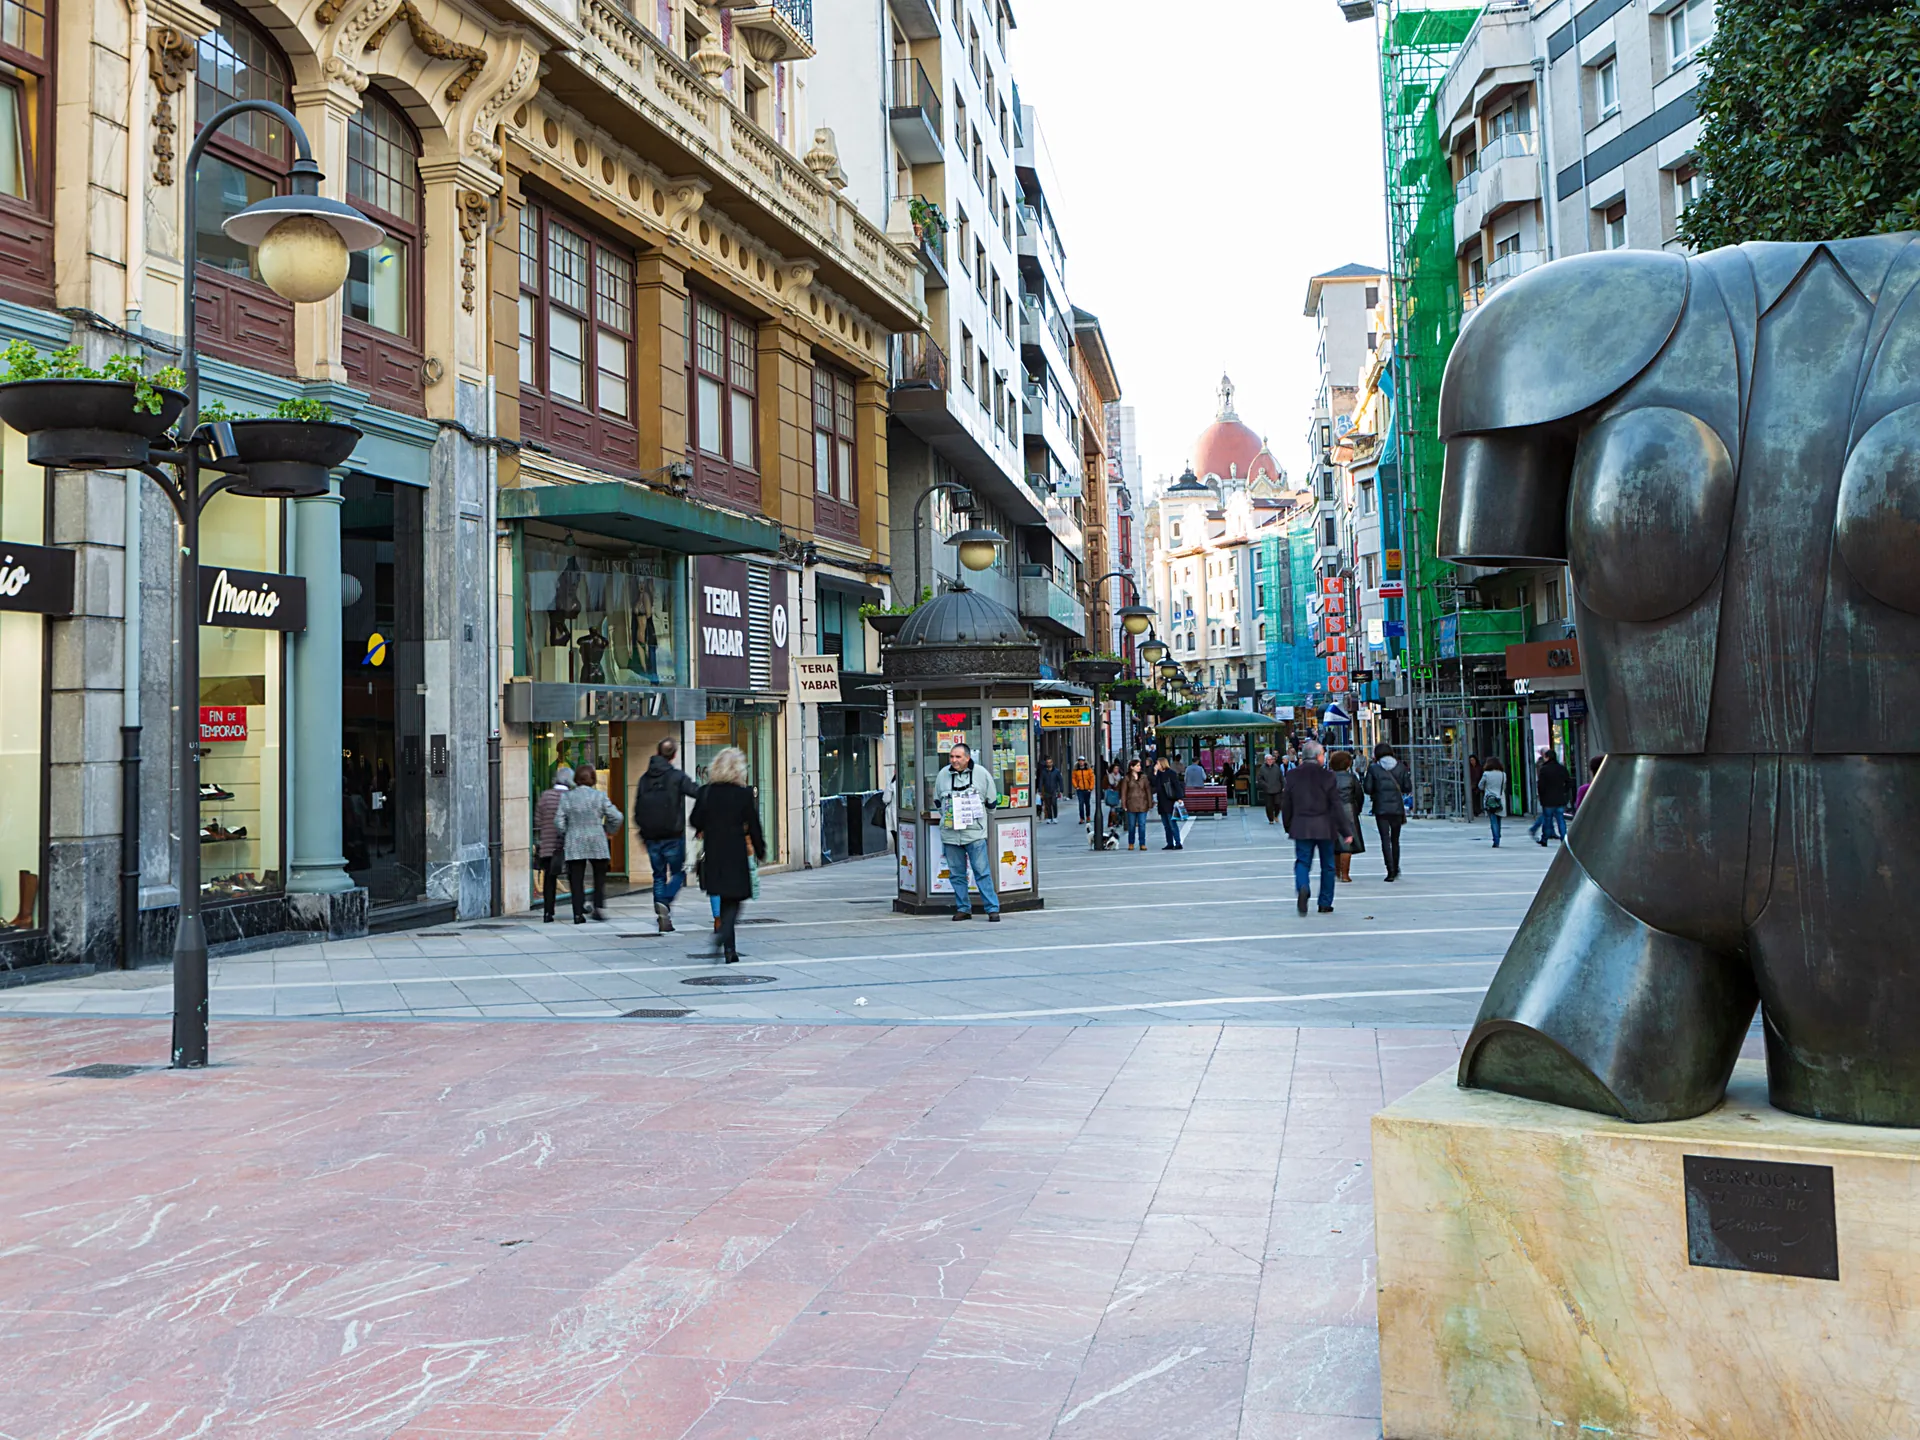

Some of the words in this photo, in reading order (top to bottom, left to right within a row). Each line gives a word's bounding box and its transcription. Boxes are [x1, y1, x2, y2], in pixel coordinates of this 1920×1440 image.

[206, 569, 280, 623] Mario
[703, 585, 742, 618] TERIA
[702, 626, 744, 658] YABAR
[1327, 577, 1346, 691] CASINO
[801, 664, 834, 674] TERIA
[801, 679, 838, 690] YABAR
[209, 710, 223, 722] FIN
[227, 712, 236, 721] DE
[200, 724, 246, 738] TEMPORADA
[1702, 1166, 1814, 1193] BERROCAL
